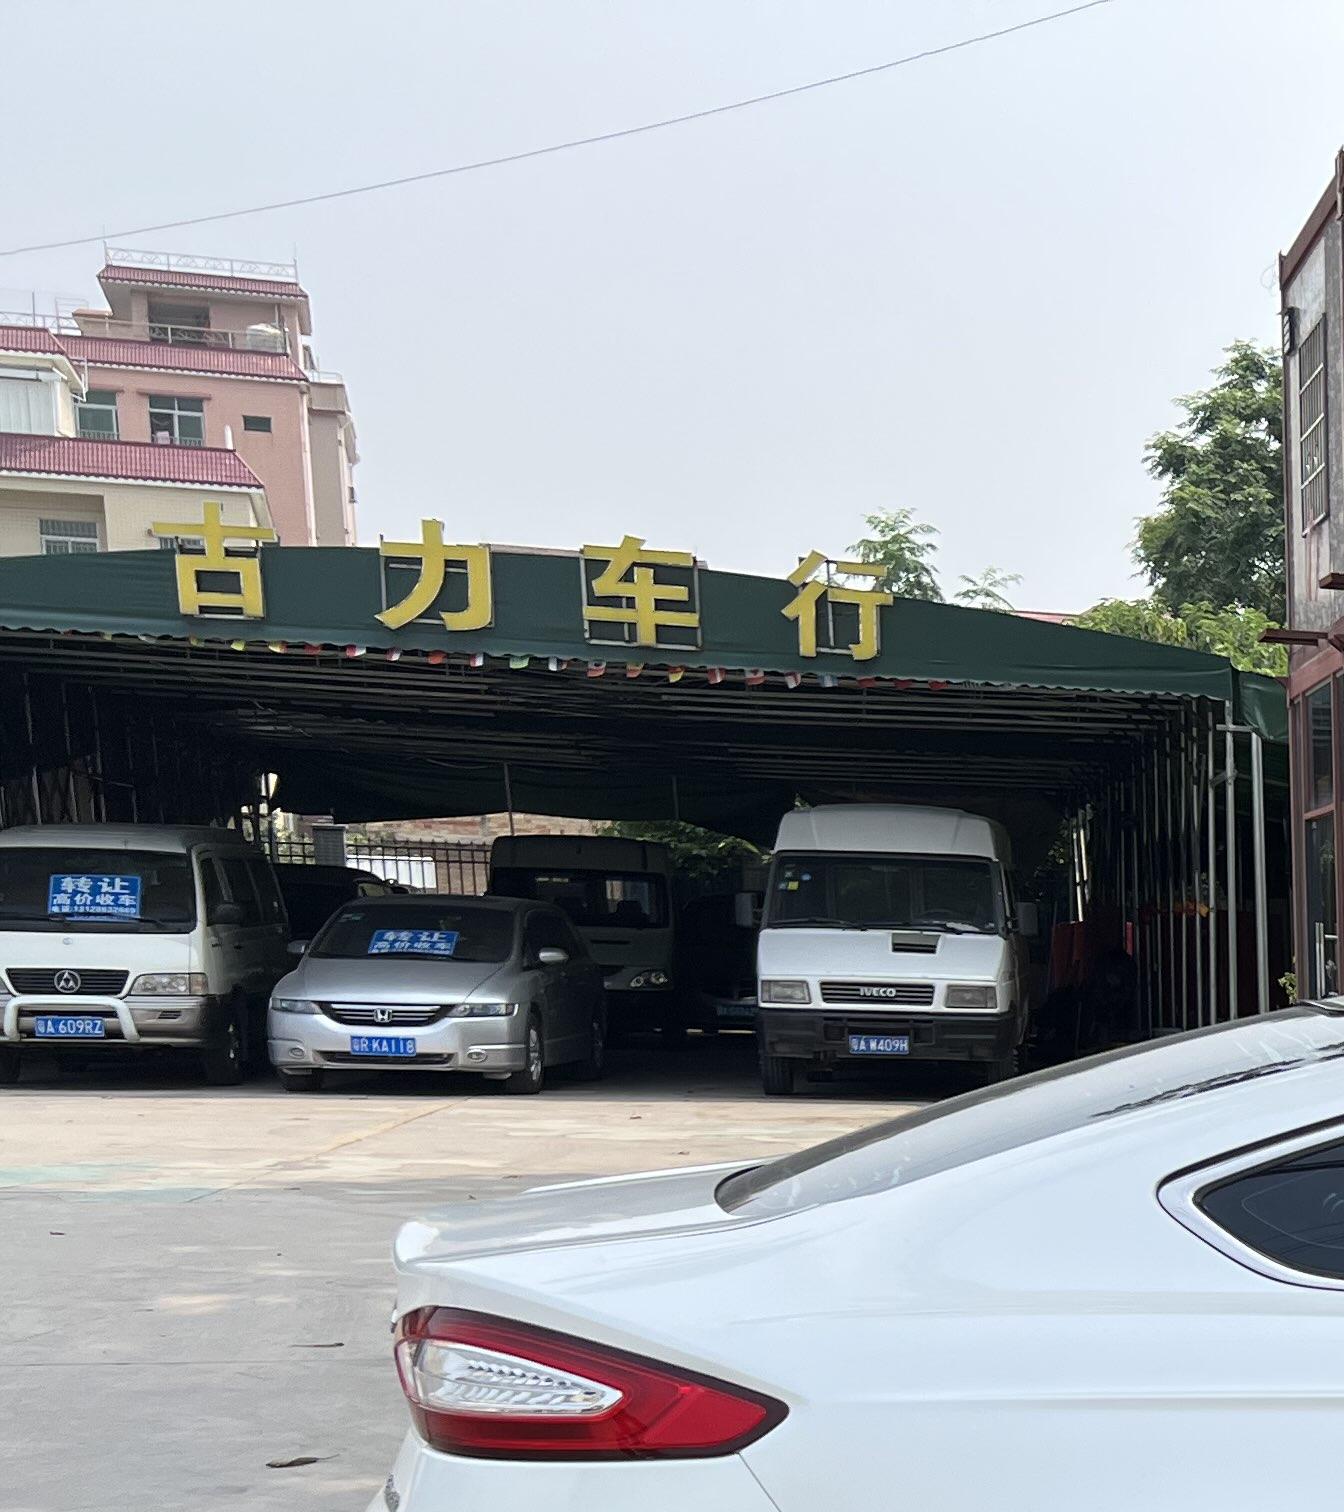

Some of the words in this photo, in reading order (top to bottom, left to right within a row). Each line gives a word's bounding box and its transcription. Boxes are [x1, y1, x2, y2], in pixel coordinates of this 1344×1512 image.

[152, 502, 893, 660] 古力车行
[52, 893, 137, 906] 高价收车
[860, 986, 896, 997] IVECO
